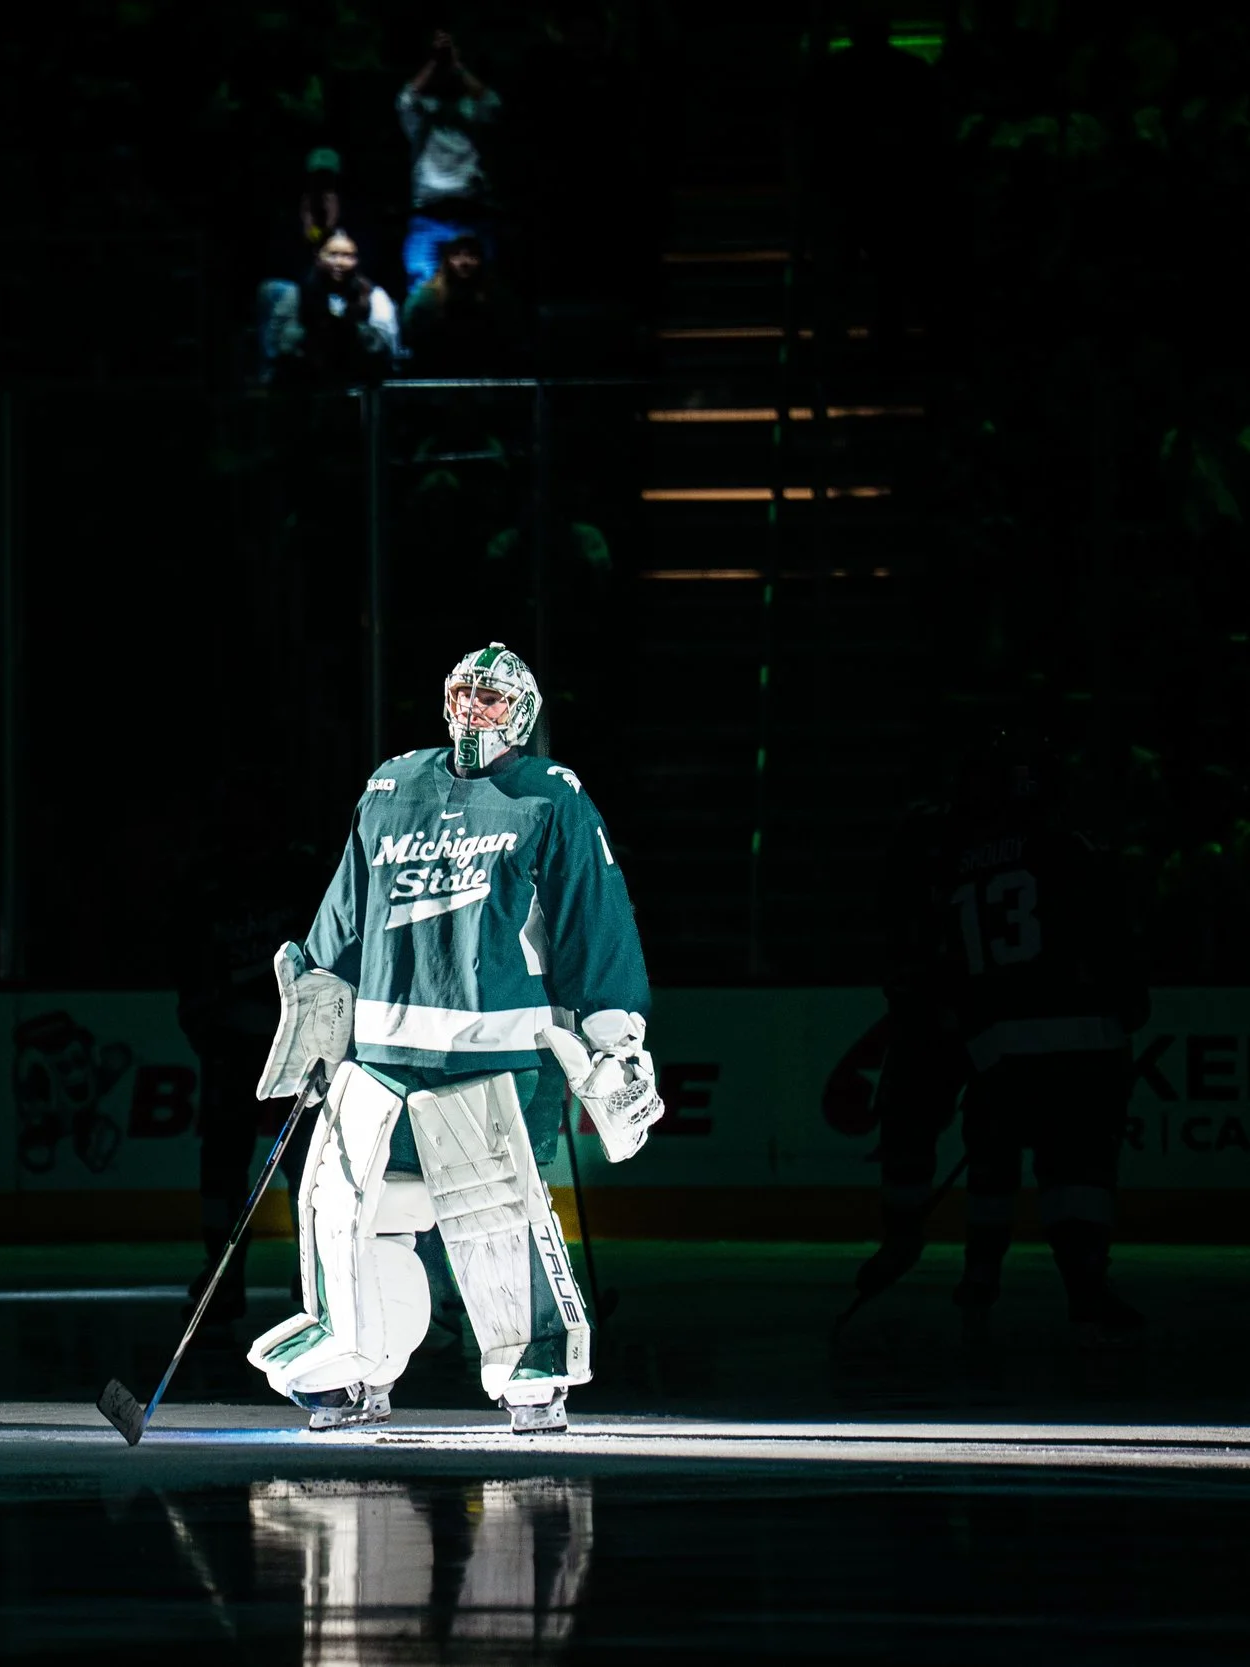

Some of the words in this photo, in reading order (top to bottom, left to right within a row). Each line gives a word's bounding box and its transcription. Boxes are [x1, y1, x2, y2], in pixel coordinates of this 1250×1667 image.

[458, 737, 479, 767] S
[372, 828, 518, 868] Michigan
[389, 865, 488, 900] State
[950, 869, 1042, 976] 13
[540, 1225, 580, 1324] TRUE
